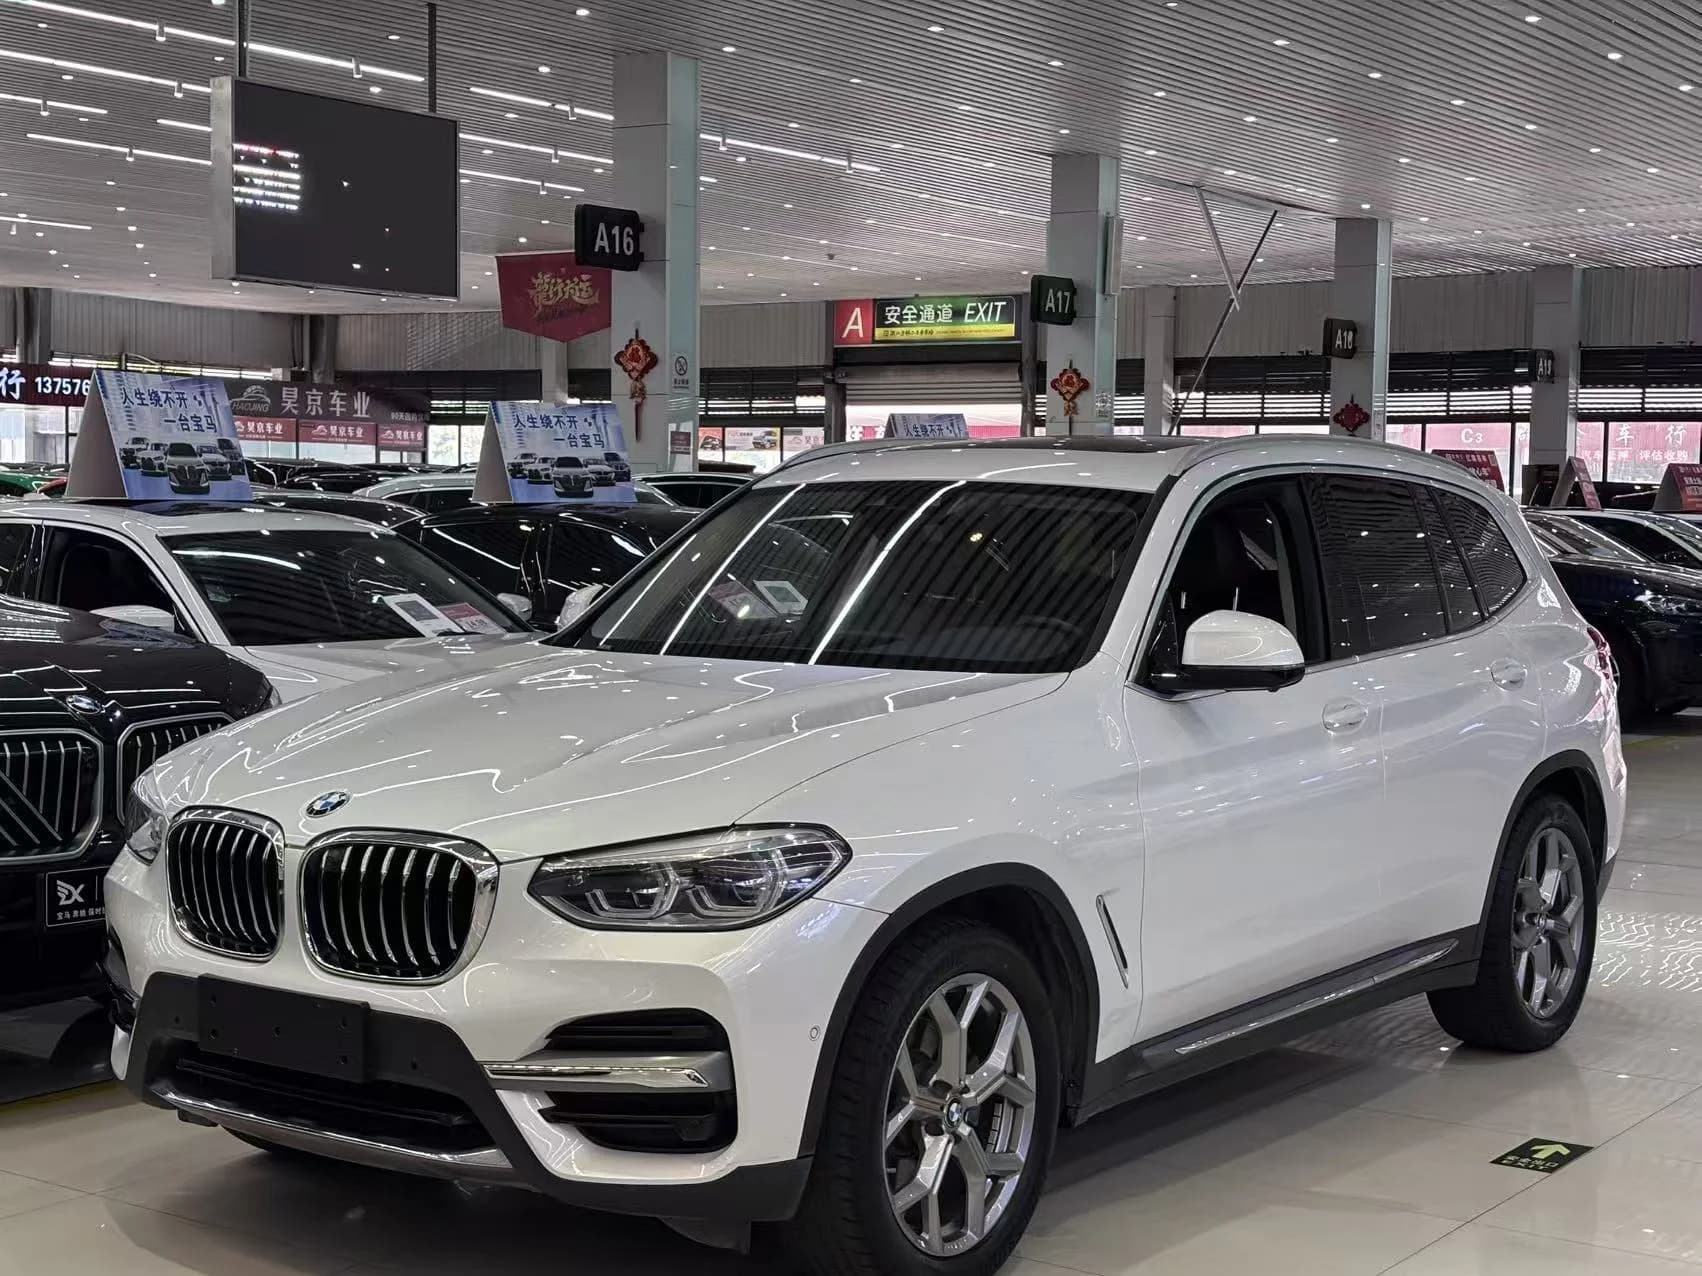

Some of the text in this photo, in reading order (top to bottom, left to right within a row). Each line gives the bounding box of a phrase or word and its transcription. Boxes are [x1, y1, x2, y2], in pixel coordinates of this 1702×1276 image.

[594, 223, 634, 256] A16
[1045, 289, 1071, 313] A17
[842, 307, 865, 338] A
[885, 302, 1007, 324] 安全通道 EXIT
[0, 367, 91, 400] 行 137576
[121, 387, 189, 409] 人生绕不开
[281, 387, 370, 418] 昊京车业
[163, 414, 218, 433] 一台宝马
[247, 421, 283, 434] 昊京车业
[514, 414, 578, 429] 人生绕不开
[553, 433, 605, 448] 一台宝马
[1461, 428, 1483, 443] C3
